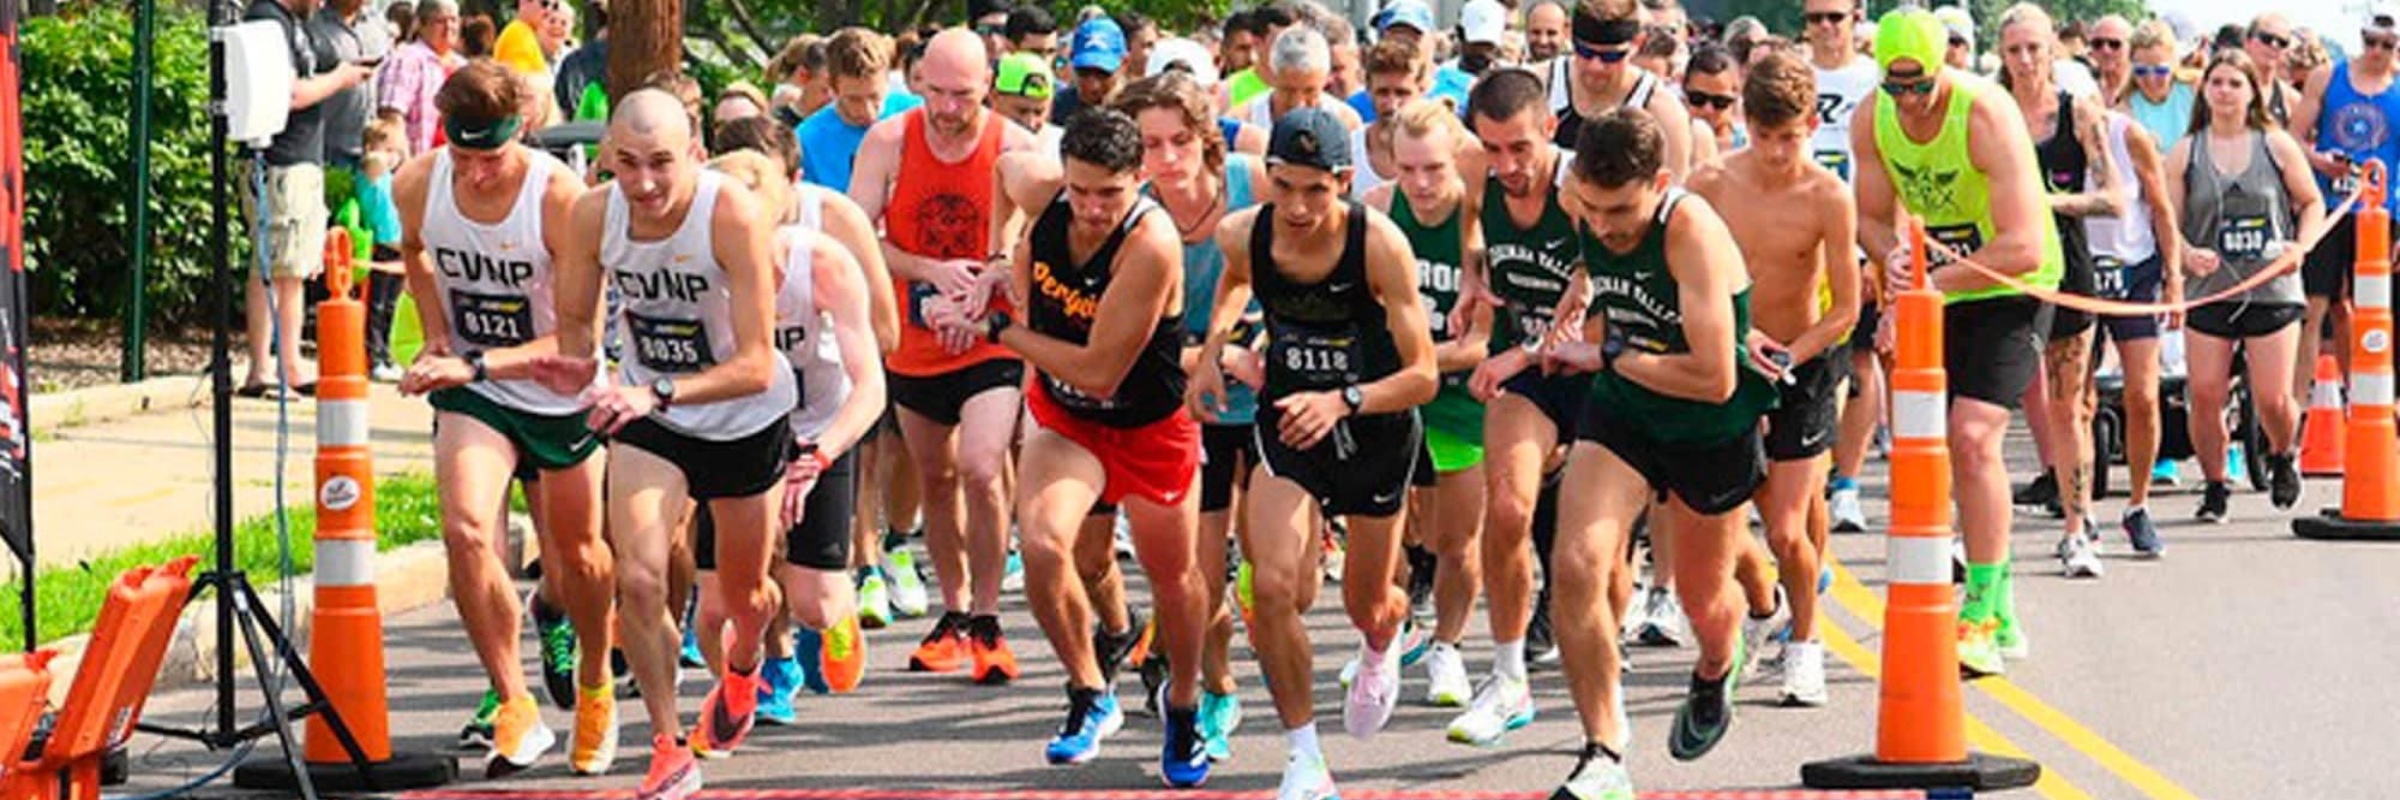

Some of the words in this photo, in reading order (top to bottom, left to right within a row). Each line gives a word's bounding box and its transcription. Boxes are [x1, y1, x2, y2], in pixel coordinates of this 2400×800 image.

[436, 247, 533, 287] CVNP
[615, 267, 709, 302] CVNP
[1285, 346, 1349, 371] 8118
